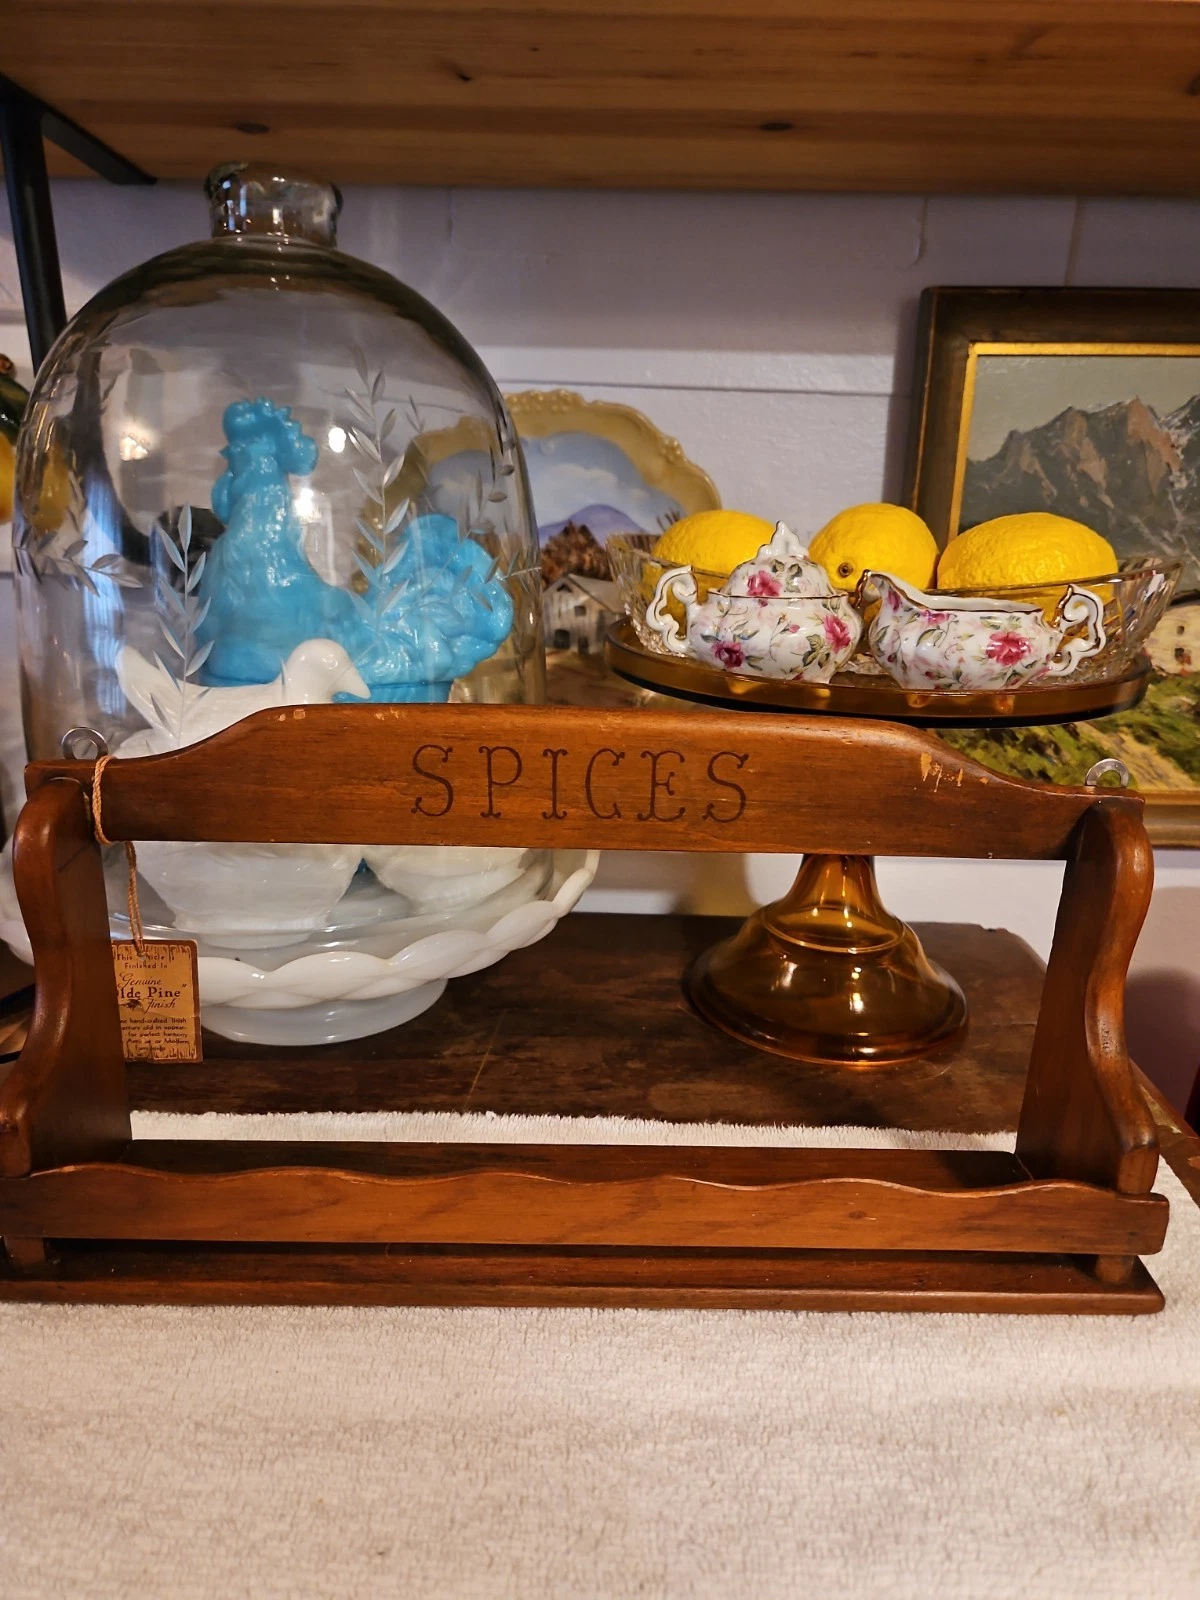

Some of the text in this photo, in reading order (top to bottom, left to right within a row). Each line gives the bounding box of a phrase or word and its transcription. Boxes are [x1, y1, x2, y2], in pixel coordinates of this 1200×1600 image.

[410, 744, 749, 823] SPICES
[118, 972, 162, 988] Genuine
[120, 987, 141, 998] lde
